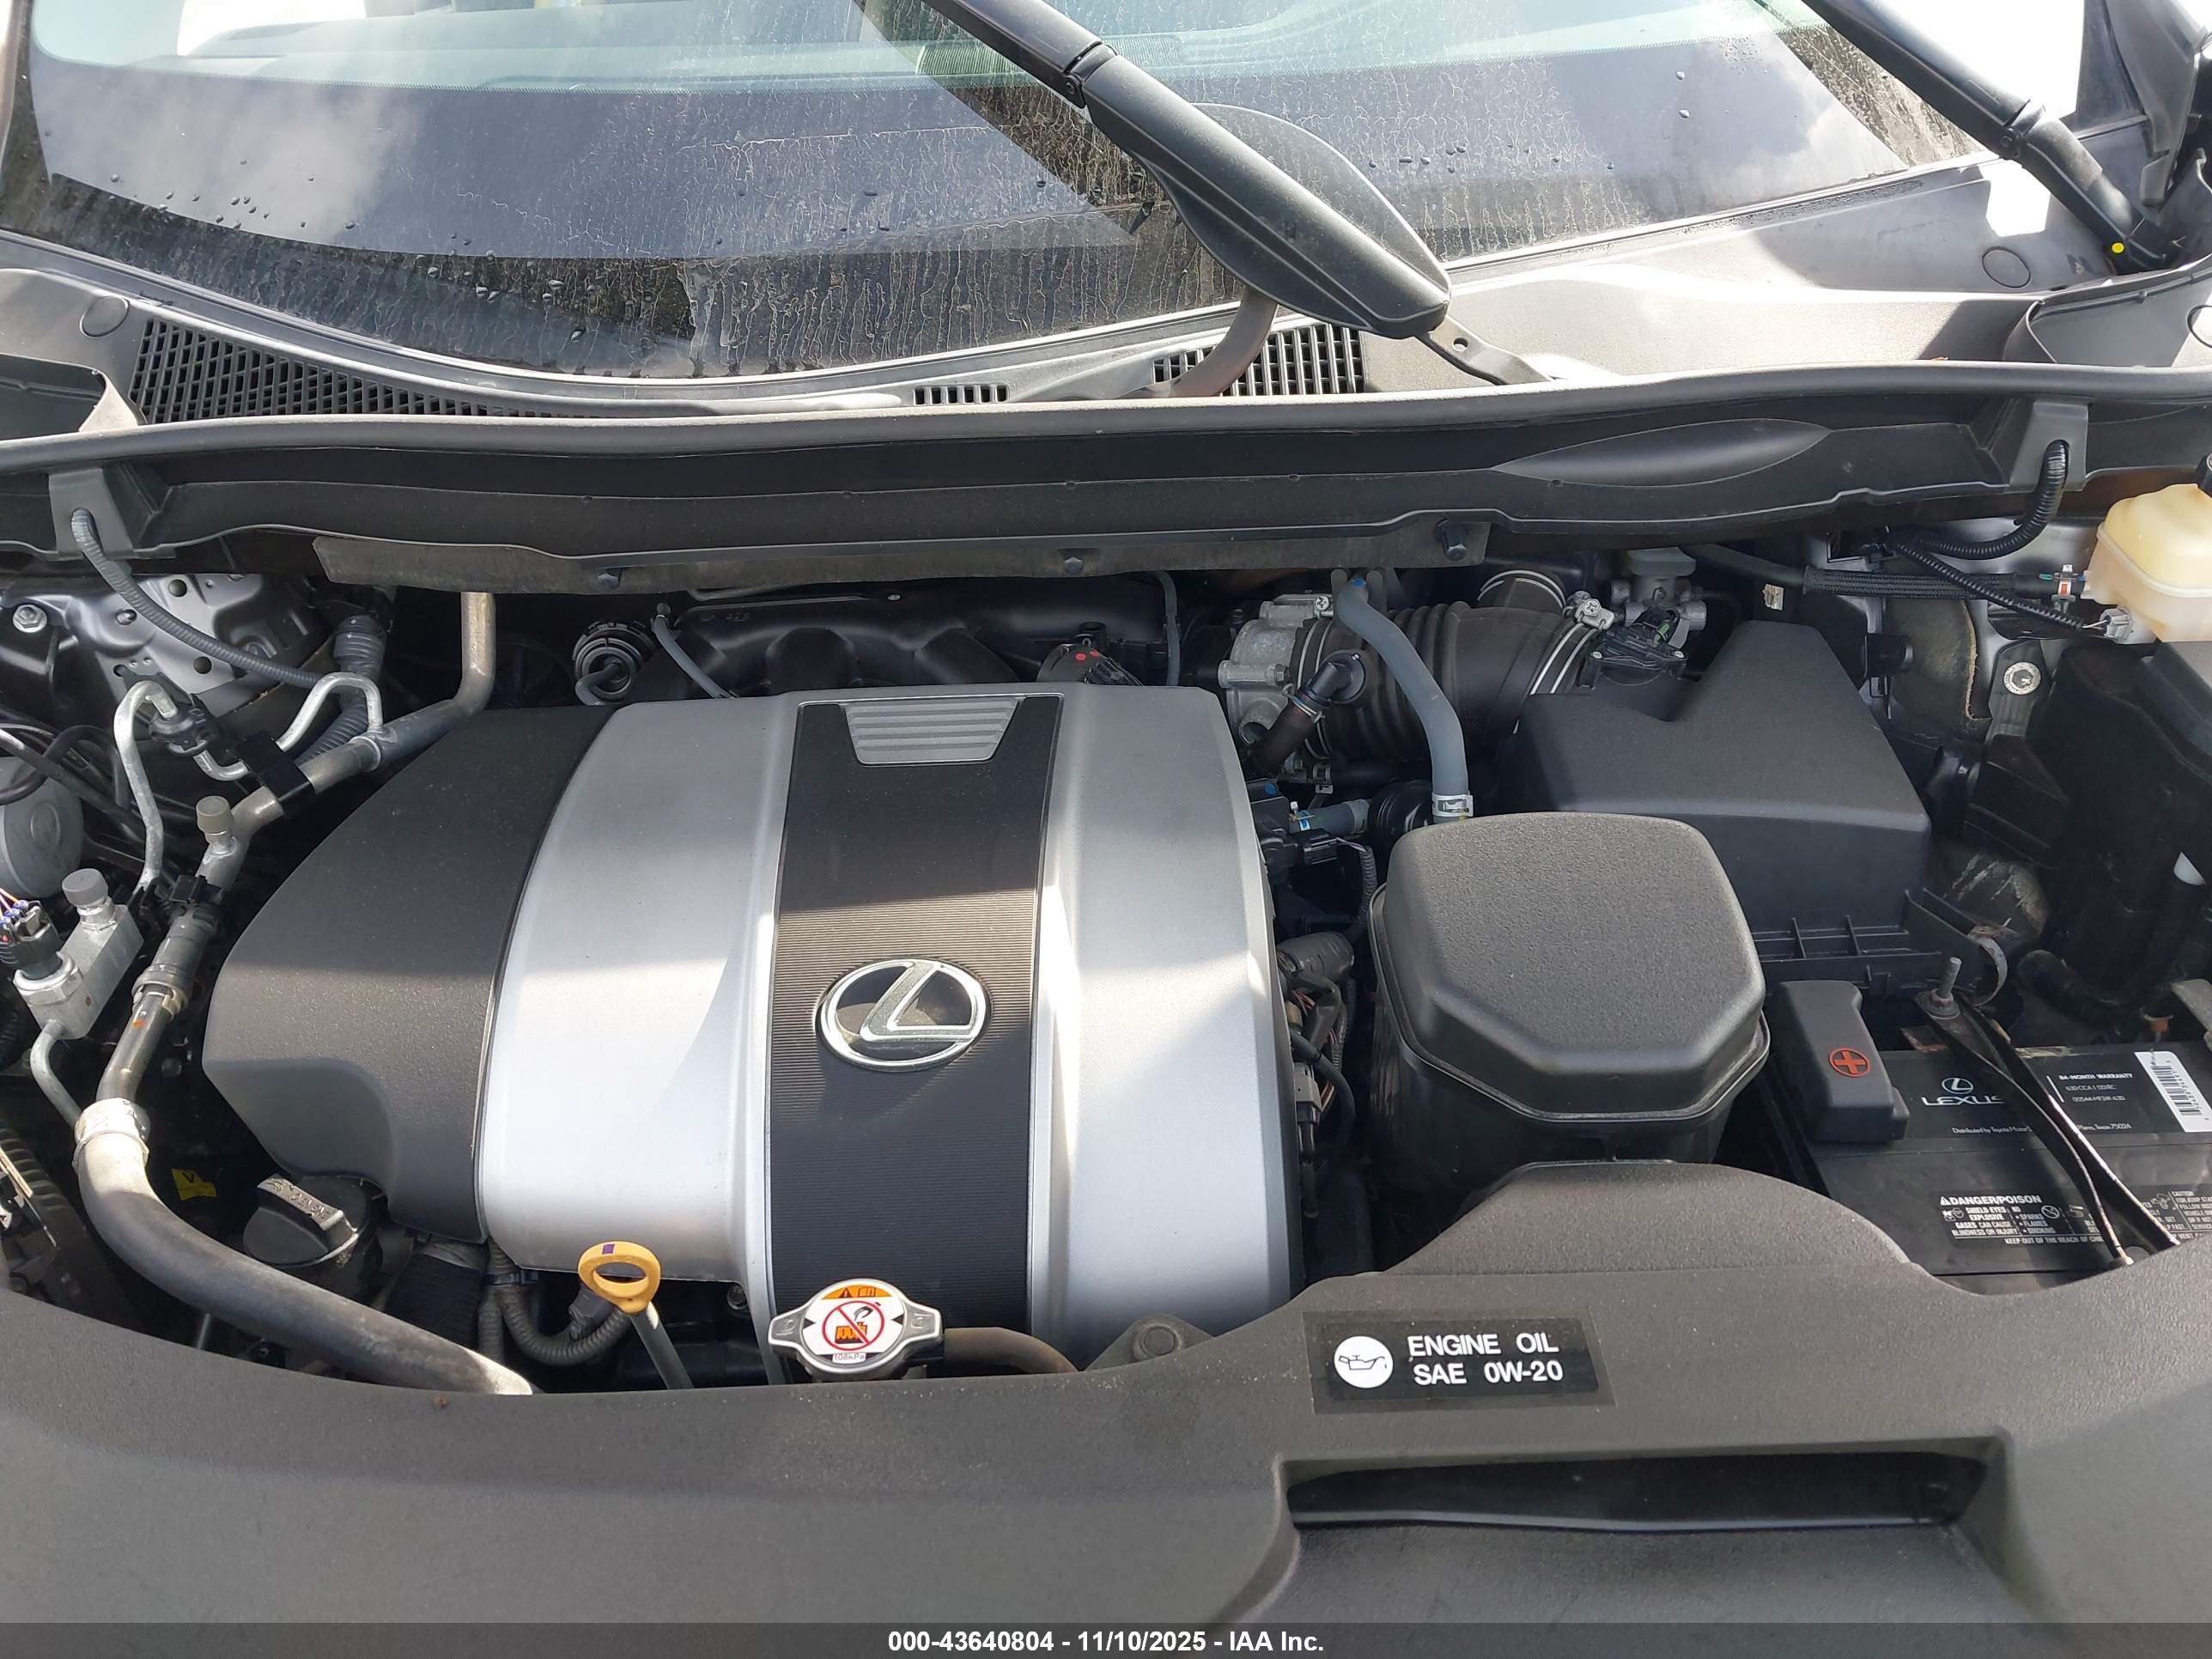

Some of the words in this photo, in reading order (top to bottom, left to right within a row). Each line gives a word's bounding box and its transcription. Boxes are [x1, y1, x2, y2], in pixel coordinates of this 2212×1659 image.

[1948, 1195, 2043, 1205] DANGER/POISON
[1407, 1334, 1501, 1357] ENGINE
[1516, 1333, 1559, 1354] OIL
[1413, 1363, 1467, 1386] SAE
[1484, 1360, 1563, 1383] 0W-20
